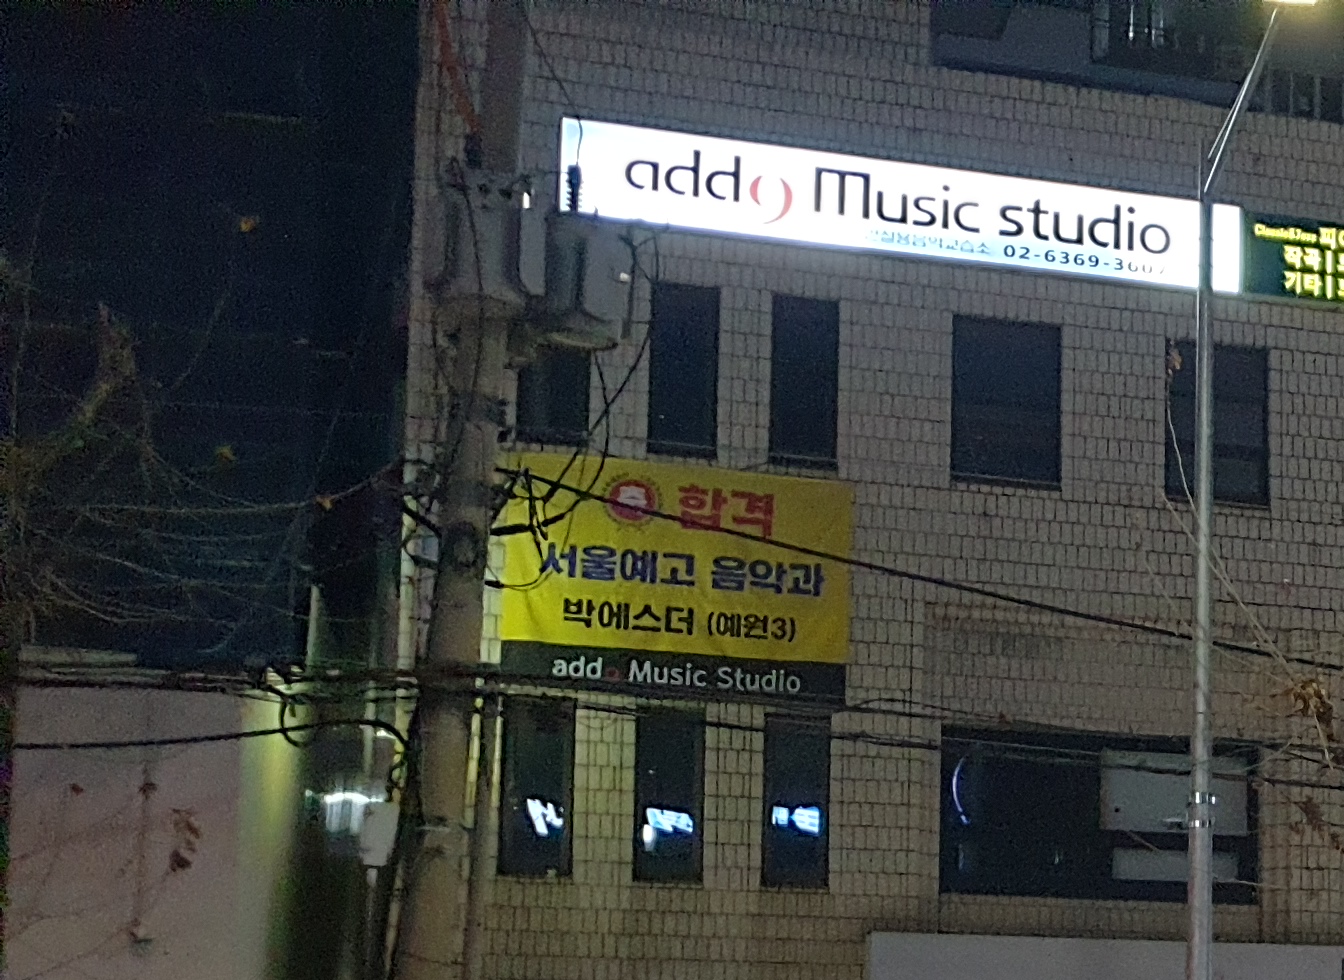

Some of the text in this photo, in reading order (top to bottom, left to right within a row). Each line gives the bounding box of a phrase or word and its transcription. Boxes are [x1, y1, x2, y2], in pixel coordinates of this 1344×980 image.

[813, 167, 980, 233] Music
[998, 199, 1171, 255] studio
[678, 484, 776, 538] 합격
[540, 541, 825, 597] 서울예고 음악과
[562, 598, 797, 642] 박에스더 (예원3)
[629, 658, 707, 688] Music
[717, 666, 802, 693] Studio
